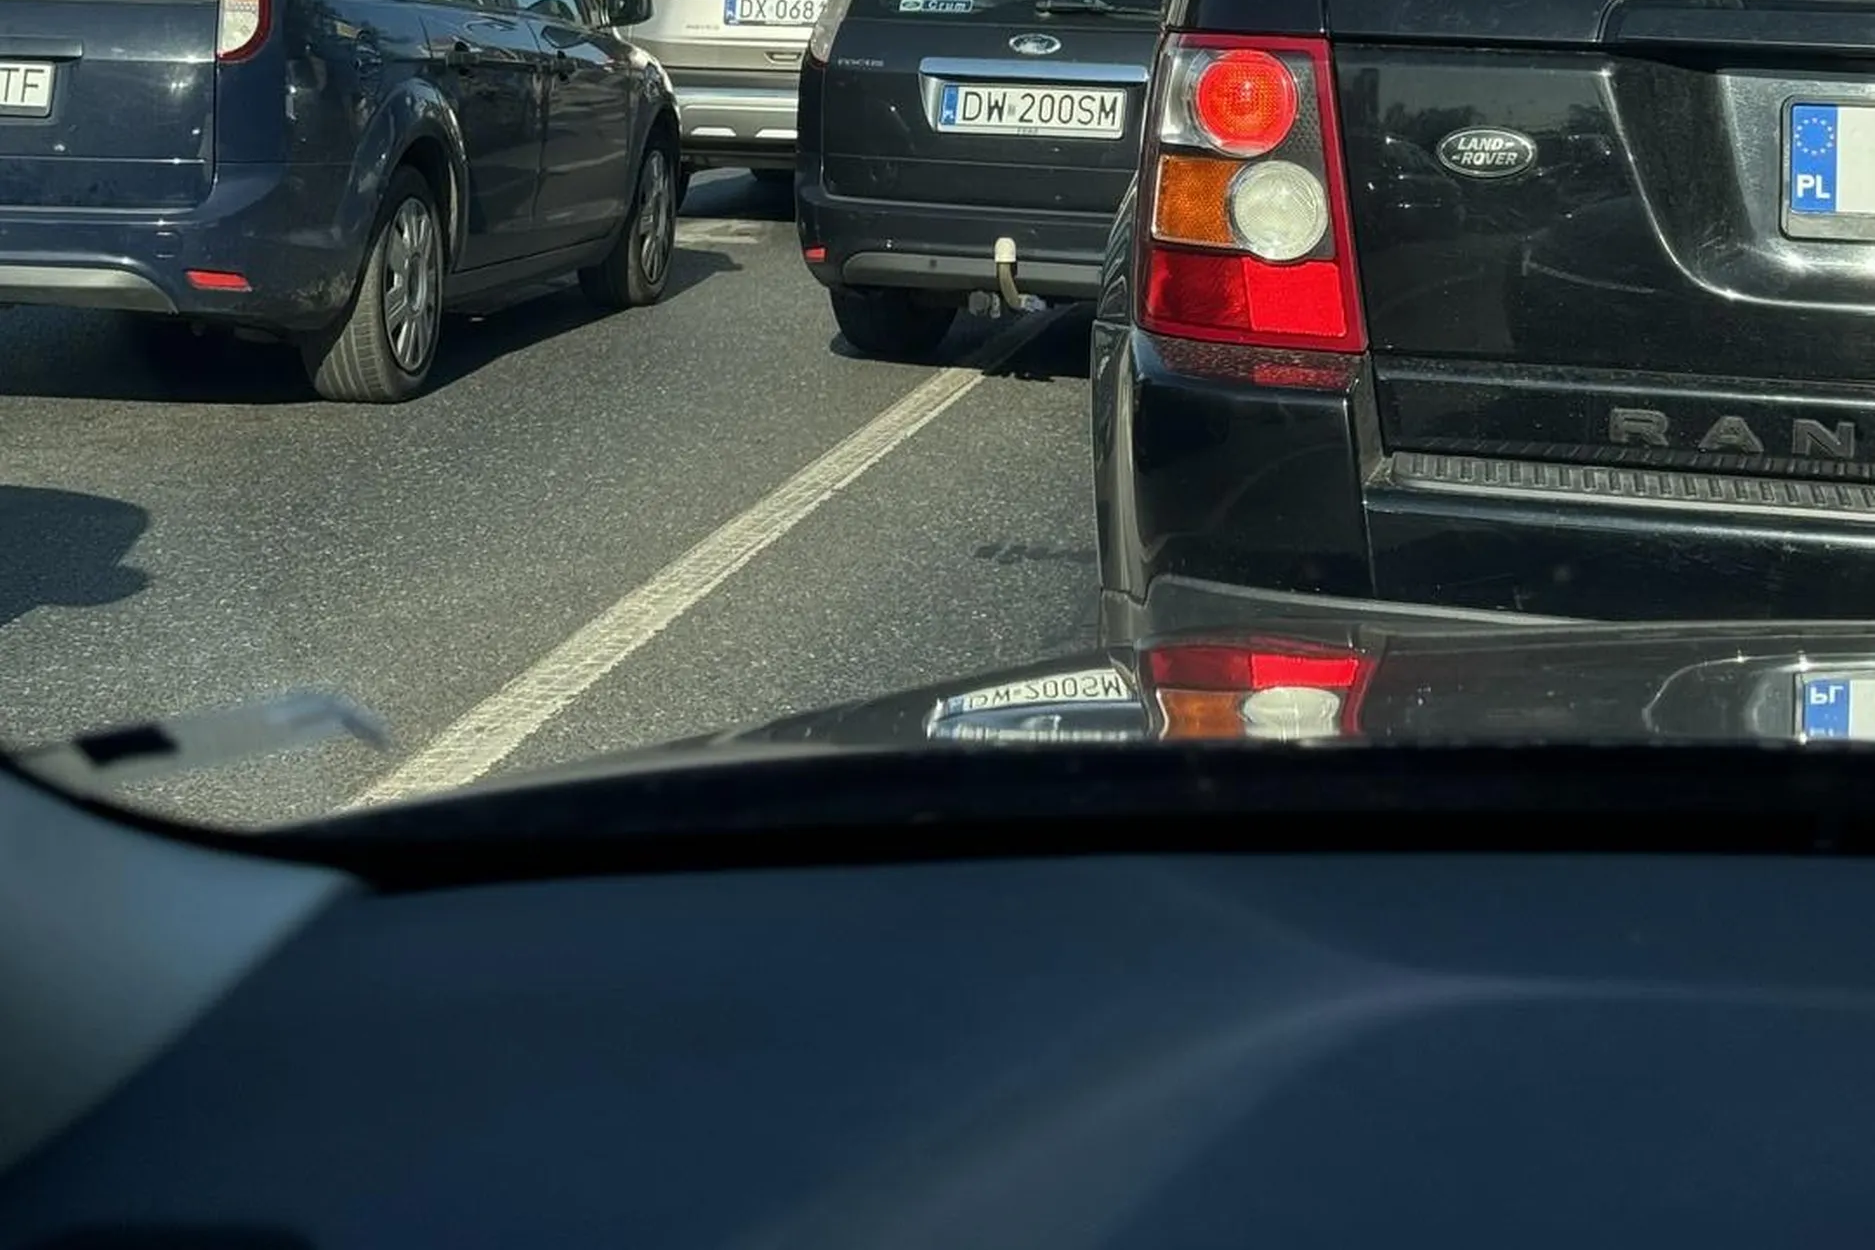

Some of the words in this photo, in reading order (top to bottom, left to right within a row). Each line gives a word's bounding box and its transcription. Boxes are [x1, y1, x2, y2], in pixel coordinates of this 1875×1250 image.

[0, 67, 44, 103] TF
[962, 91, 1007, 123] DW
[1018, 92, 1118, 126] 200SM
[1796, 174, 1831, 199] PL
[1609, 407, 1855, 459] RAN
